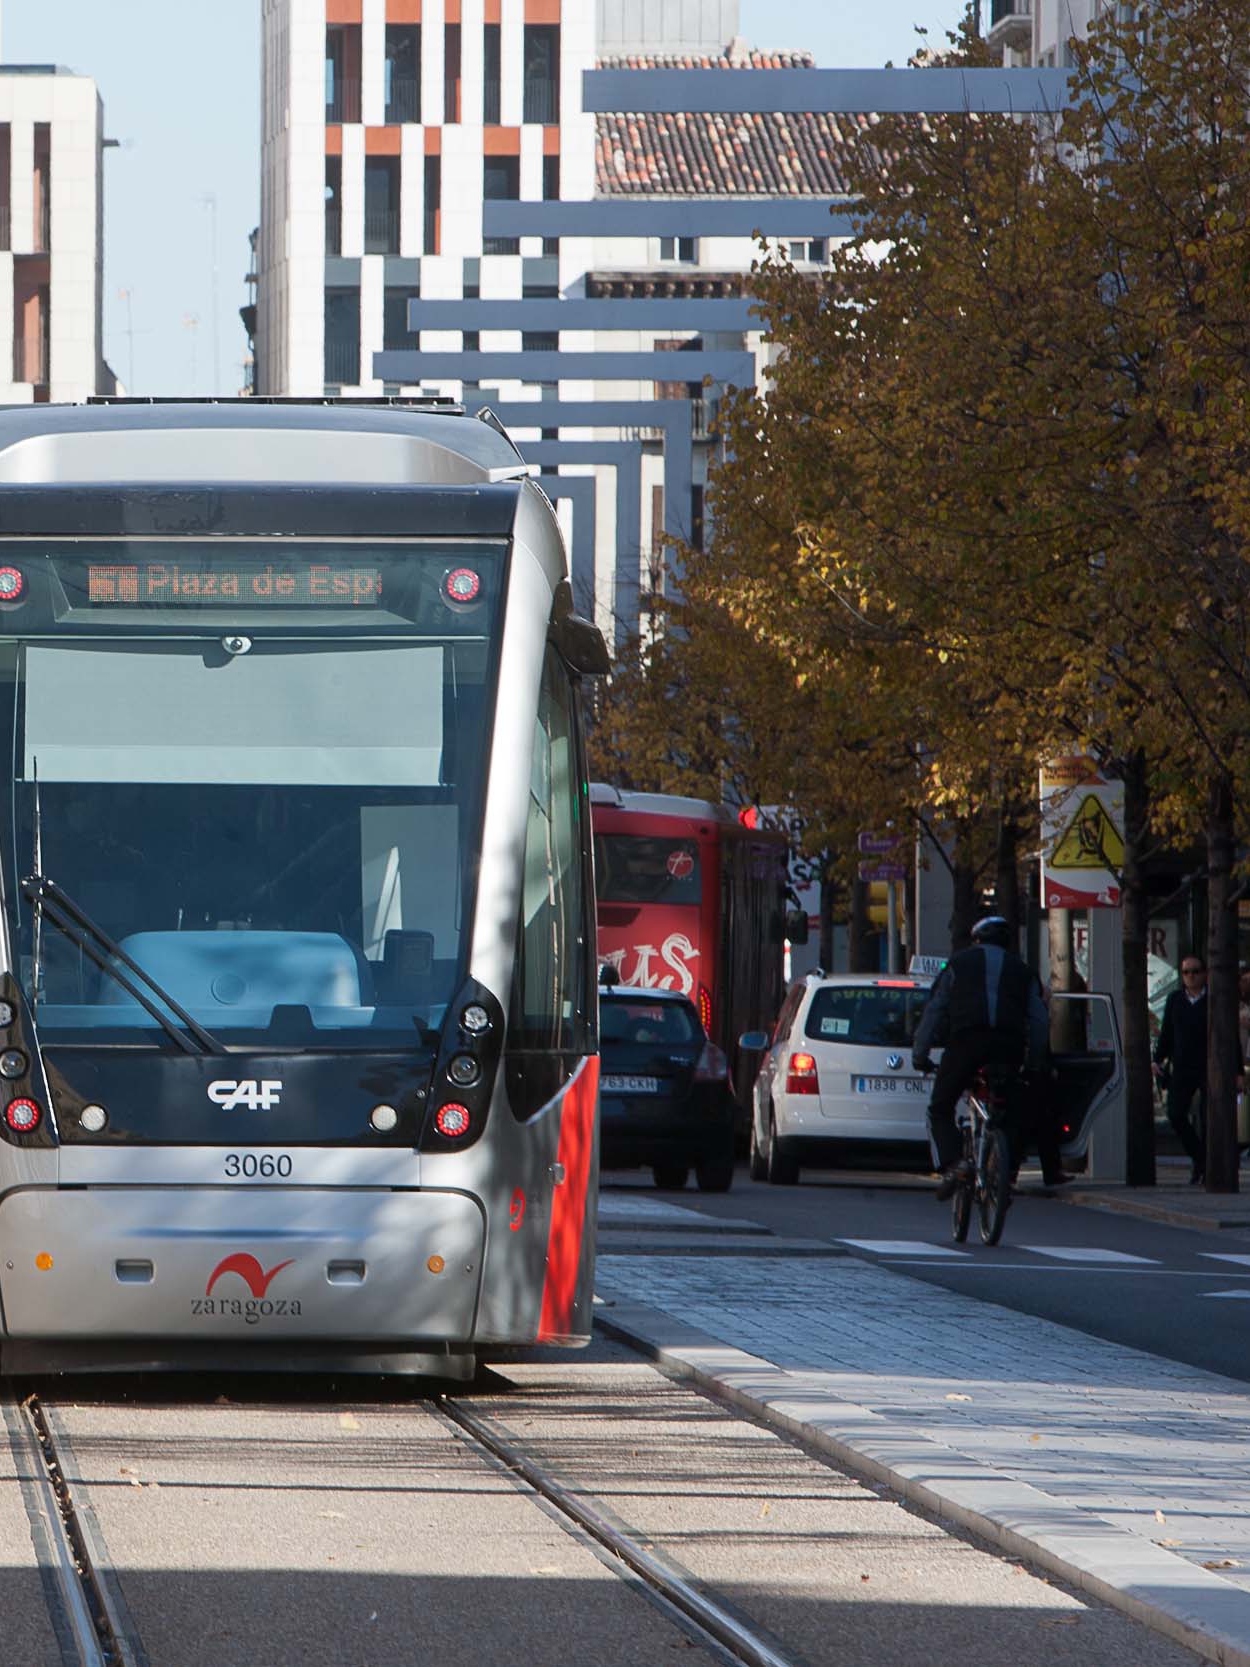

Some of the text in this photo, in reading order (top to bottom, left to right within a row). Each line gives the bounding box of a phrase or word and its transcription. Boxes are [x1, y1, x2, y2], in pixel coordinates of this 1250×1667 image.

[147, 565, 239, 595] Plaza
[253, 564, 296, 595] de
[207, 1080, 283, 1110] CAF
[224, 1153, 293, 1178] 3060
[191, 1298, 303, 1325] zaragoza
